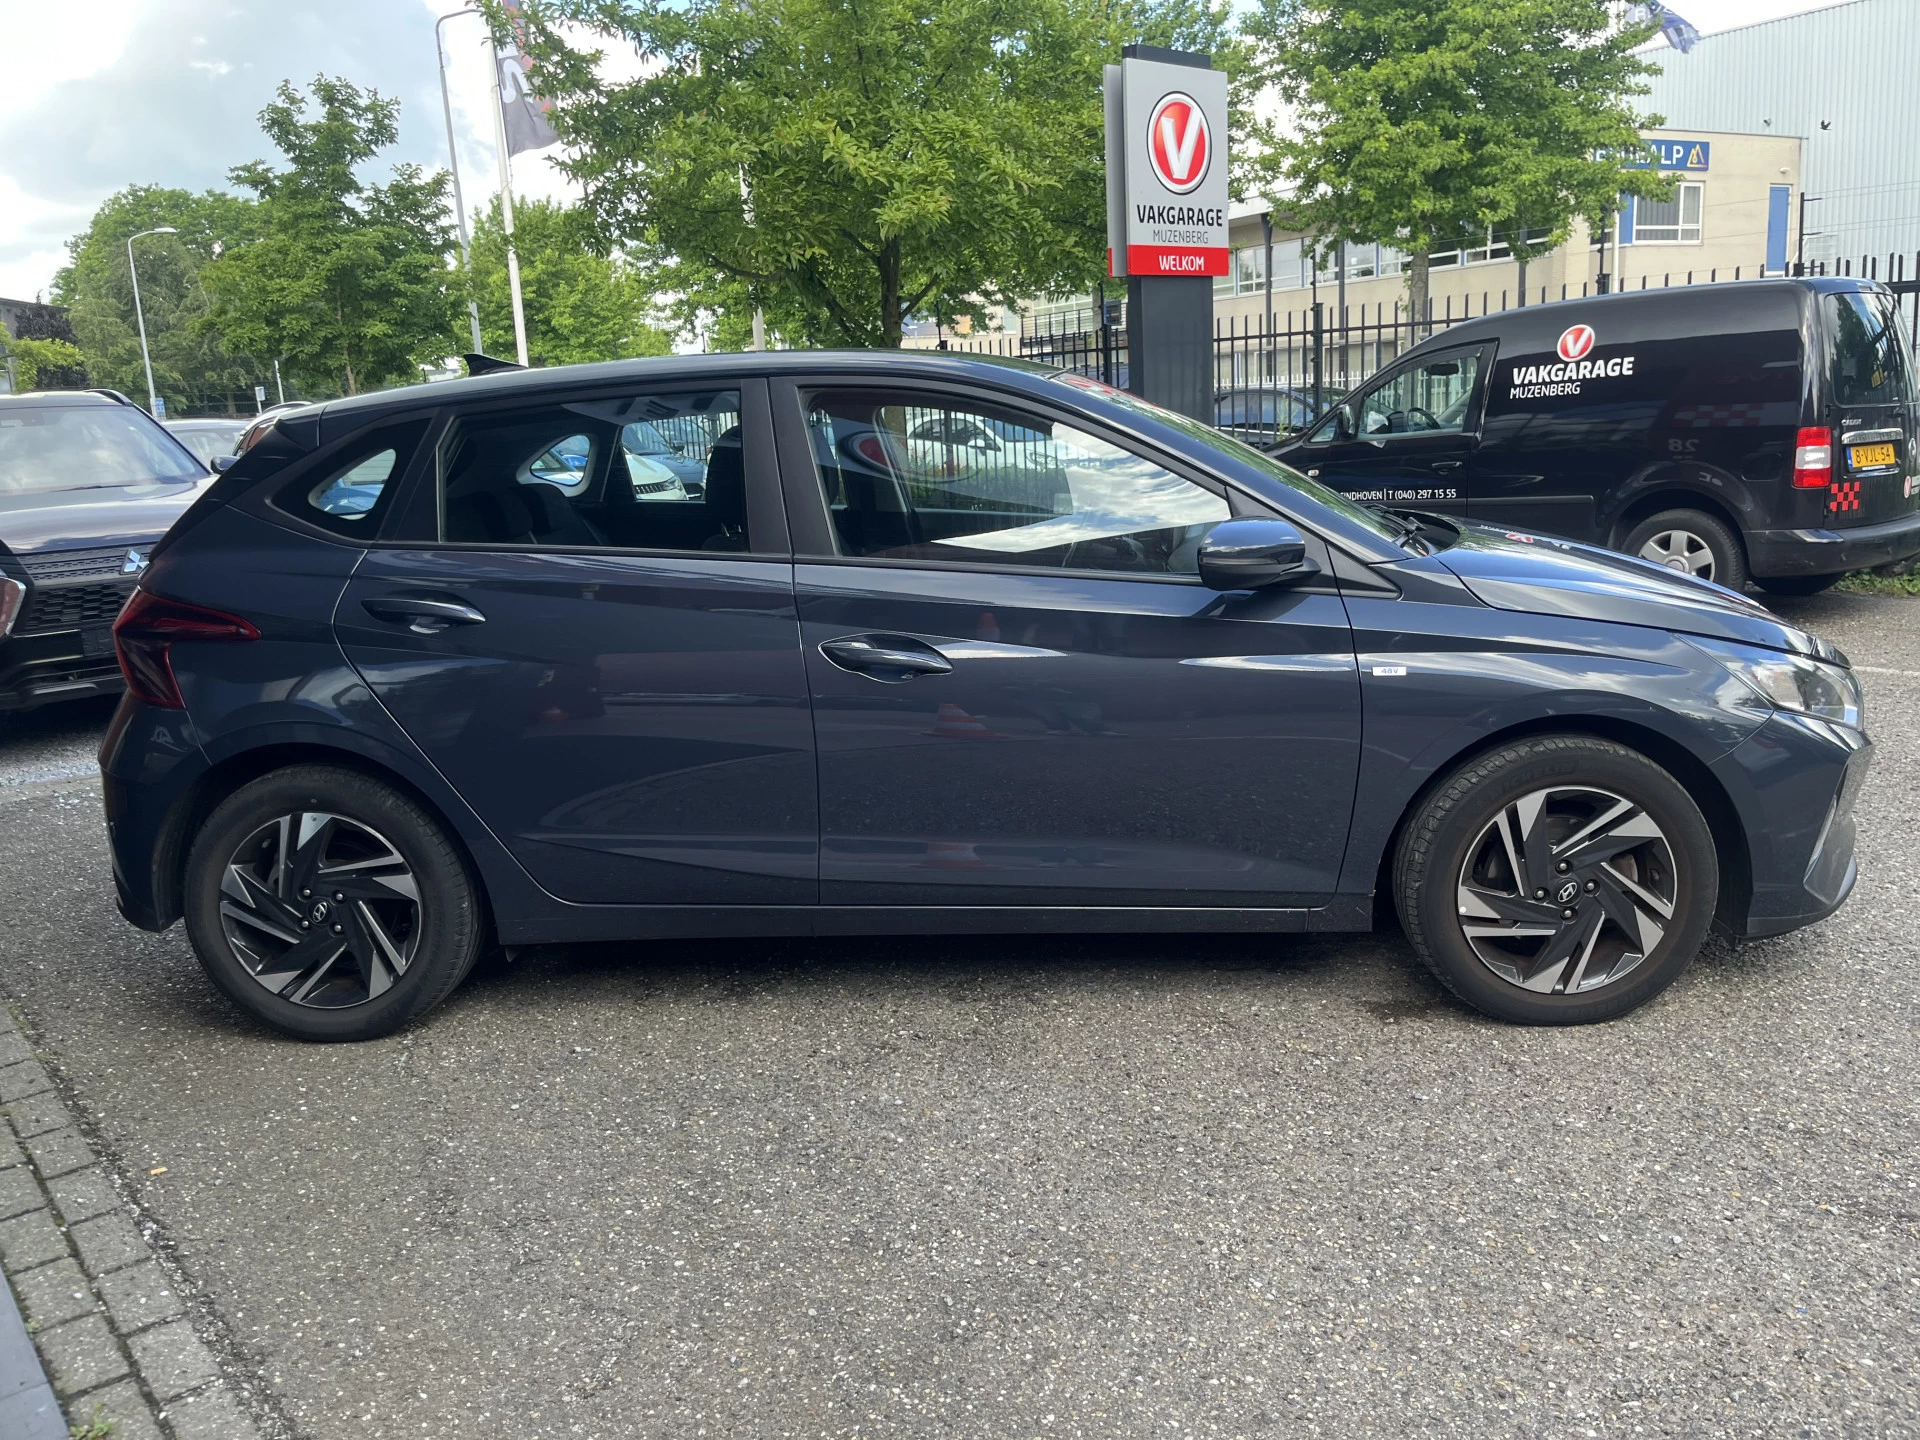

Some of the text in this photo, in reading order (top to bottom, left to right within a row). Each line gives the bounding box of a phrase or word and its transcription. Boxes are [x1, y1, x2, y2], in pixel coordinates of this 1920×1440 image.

[1136, 204, 1223, 227] VAKGARAGE
[1153, 230, 1209, 244] MUZENBERG
[1159, 255, 1205, 271] WELKOM
[1512, 356, 1635, 385] VAKGARAGE
[1509, 382, 1581, 400] MUZENBERG
[1855, 447, 1891, 464] 8-VJL-54
[1340, 488, 1457, 501] NDHOVEN T (040) 297 15 55
[1380, 667, 1399, 675] 48V
